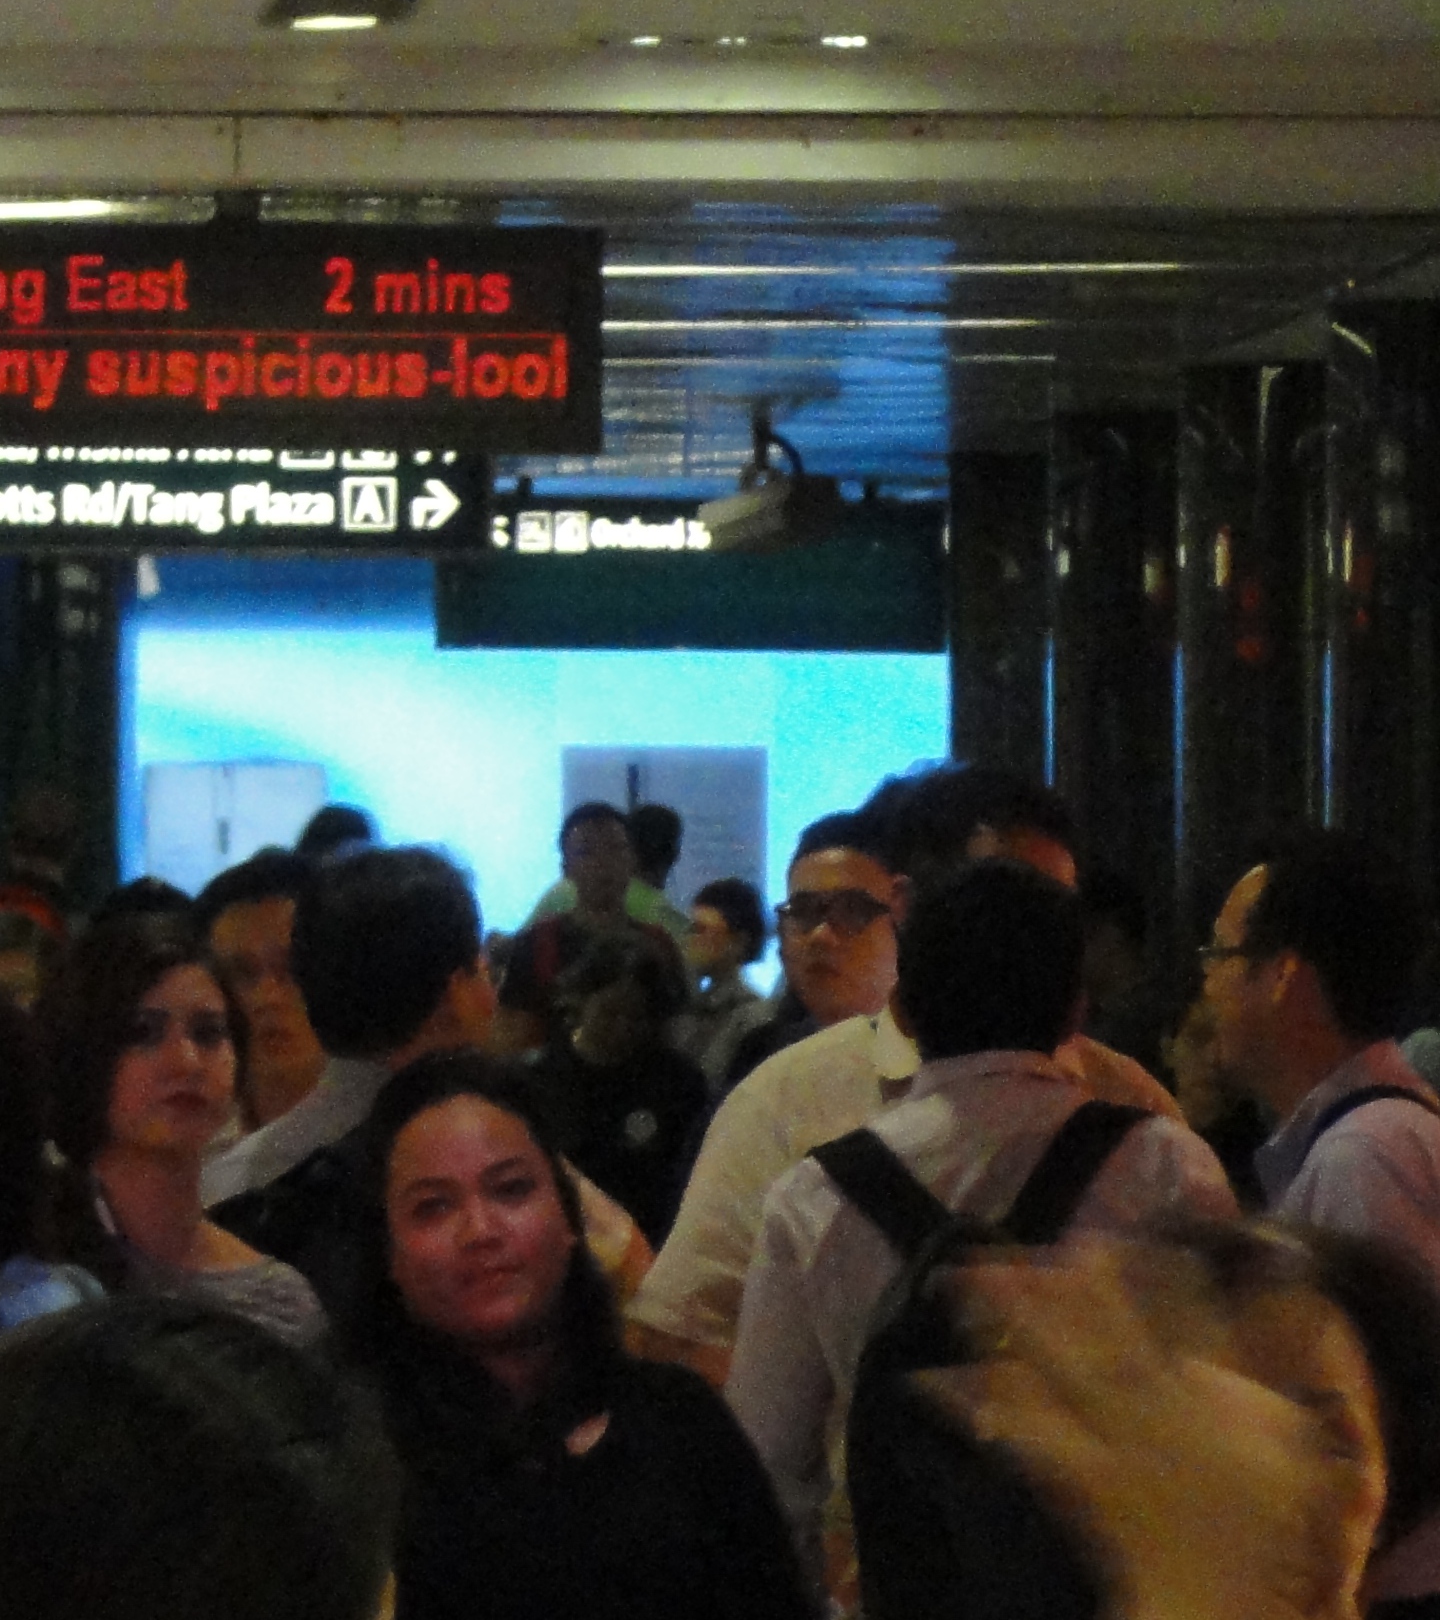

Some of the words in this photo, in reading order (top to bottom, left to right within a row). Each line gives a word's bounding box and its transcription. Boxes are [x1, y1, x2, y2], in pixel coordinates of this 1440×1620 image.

[67, 255, 188, 311] East
[325, 257, 353, 313] 2
[375, 259, 510, 313] mins
[61, 481, 224, 533] Rd/Tang
[229, 481, 335, 525] Plaza
